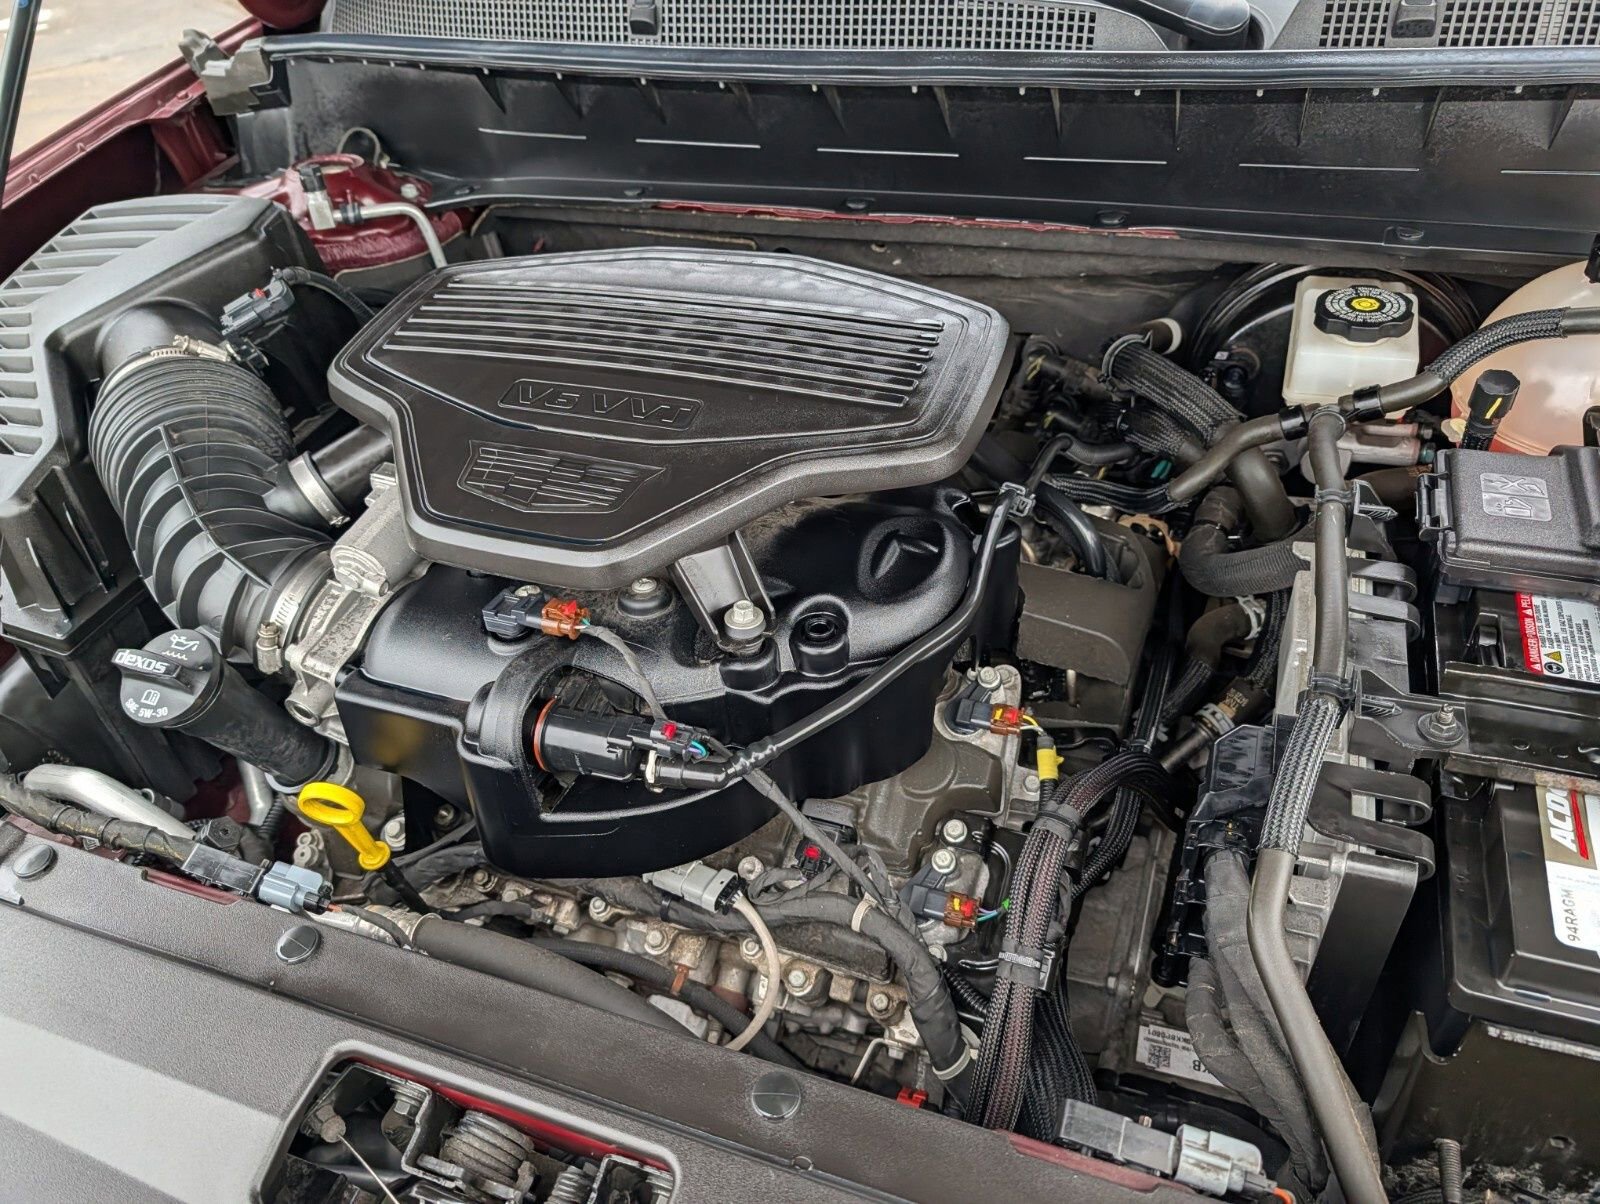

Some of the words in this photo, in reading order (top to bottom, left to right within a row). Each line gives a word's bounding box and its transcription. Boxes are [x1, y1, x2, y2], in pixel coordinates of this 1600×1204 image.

[519, 384, 583, 410] V6
[592, 393, 693, 424] VVT
[115, 650, 170, 673] dexos
[138, 707, 168, 718] 5W-30
[1545, 788, 1578, 853] ACD
[1559, 888, 1581, 943] 94RAGM
